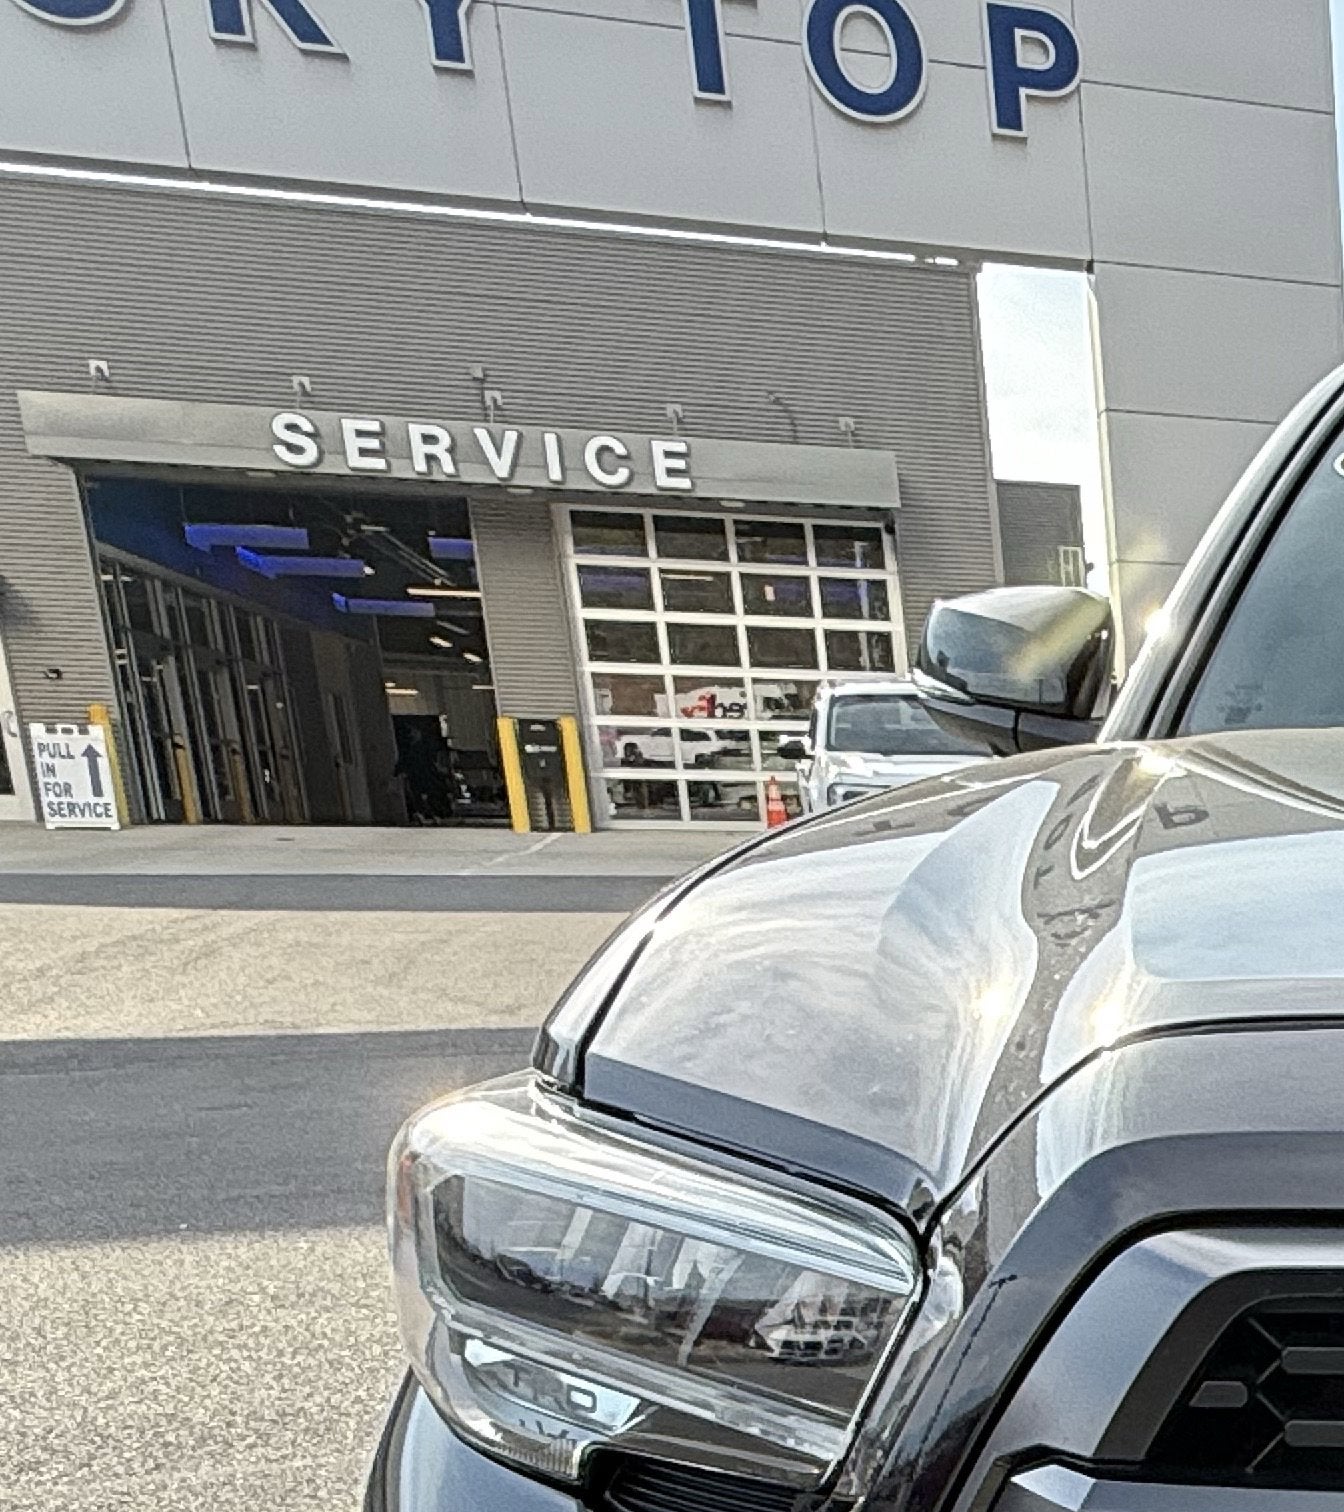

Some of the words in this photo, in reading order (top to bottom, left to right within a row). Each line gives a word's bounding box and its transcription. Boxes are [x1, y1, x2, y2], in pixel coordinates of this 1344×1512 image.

[270, 412, 694, 491] SERVICE
[37, 742, 76, 760] PULL
[41, 762, 57, 778] IN
[43, 781, 74, 798] FOR
[46, 801, 113, 818] SERVICE
